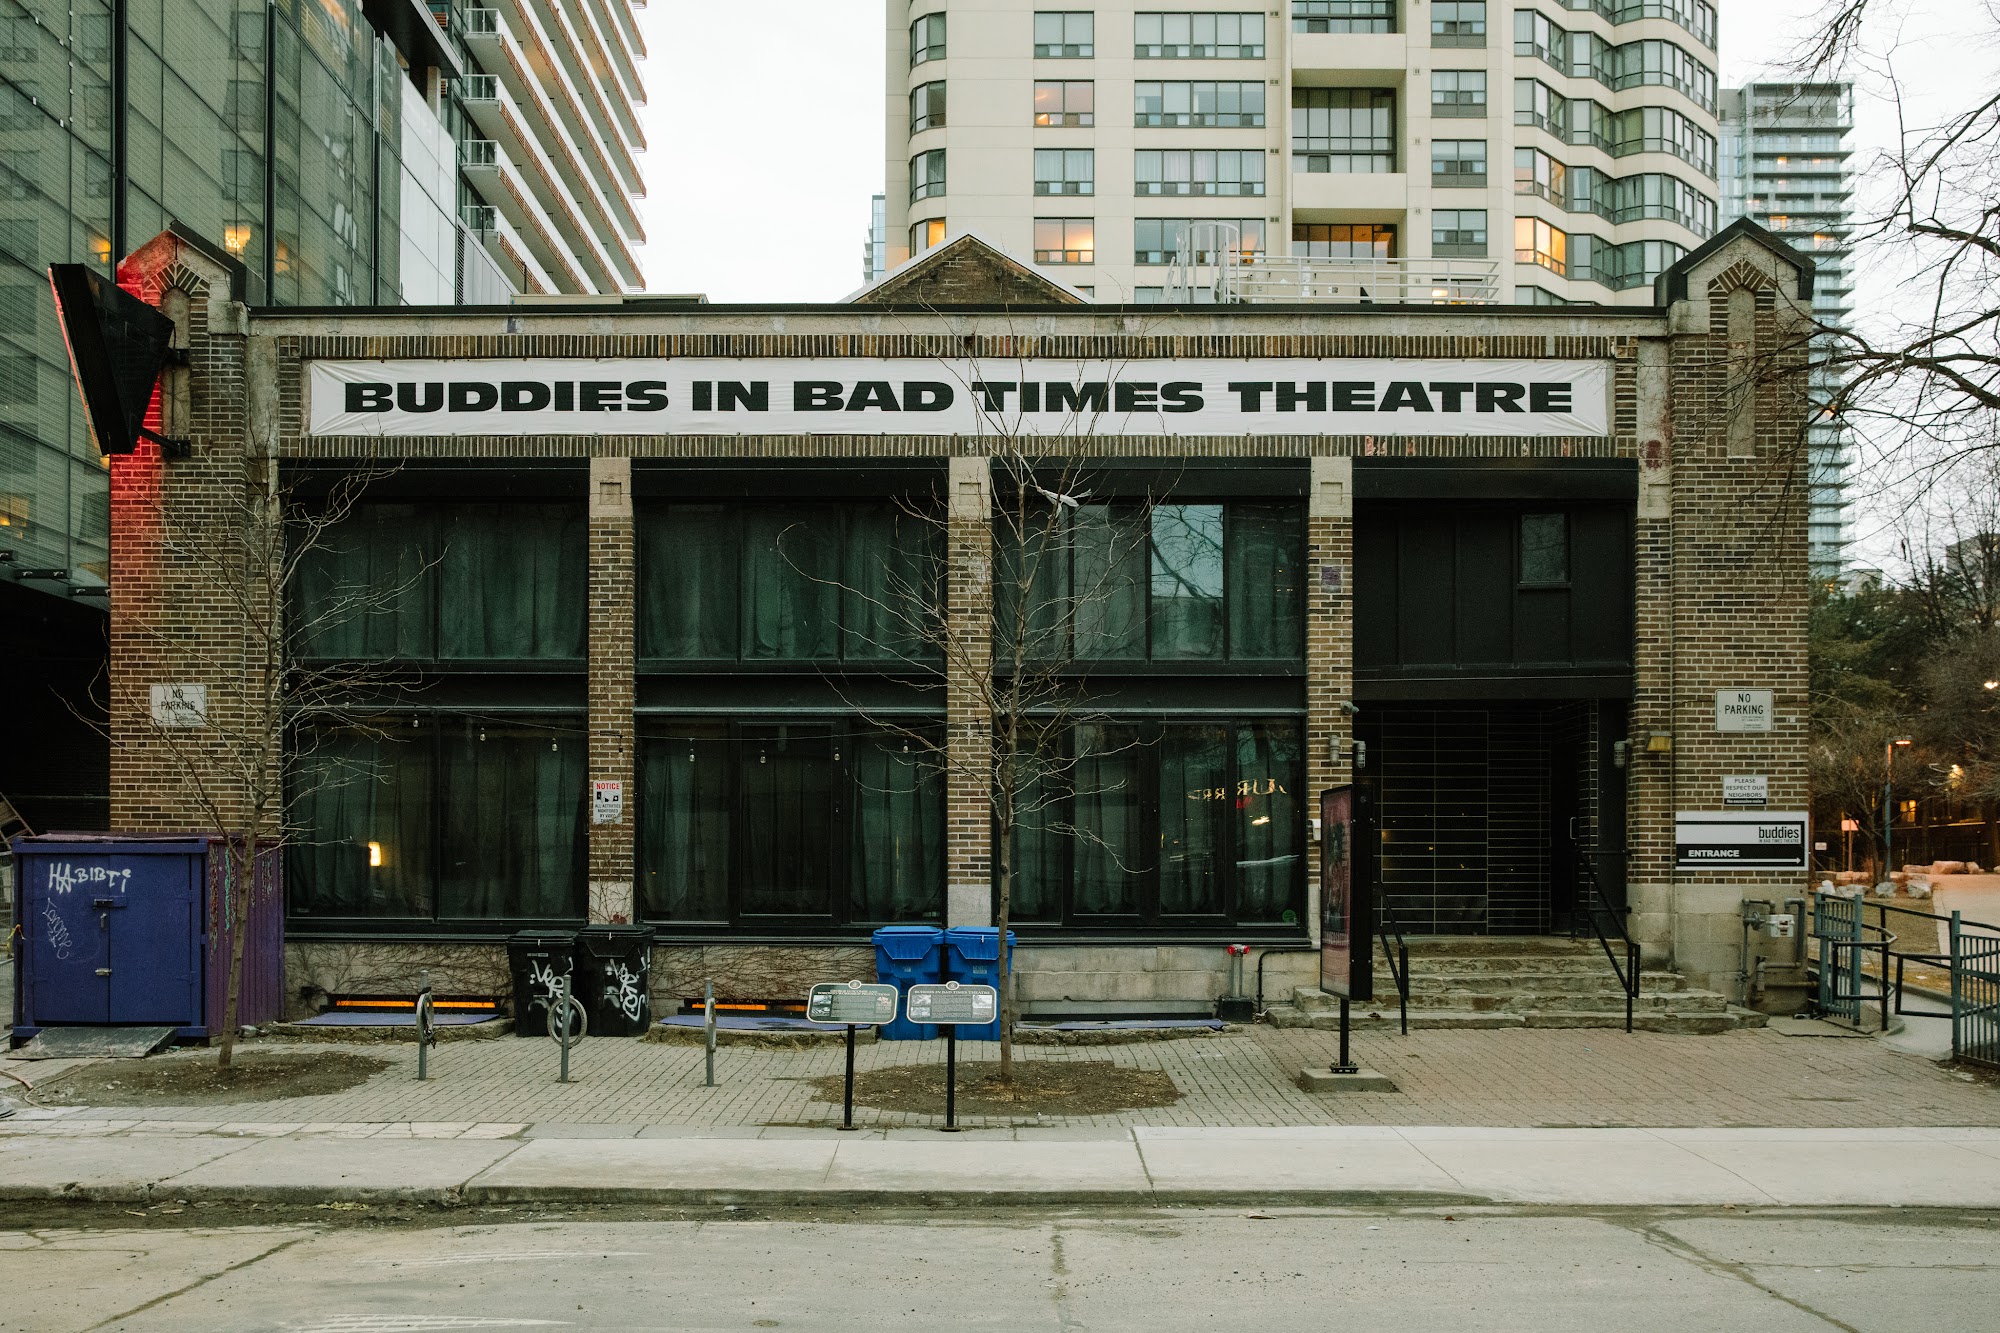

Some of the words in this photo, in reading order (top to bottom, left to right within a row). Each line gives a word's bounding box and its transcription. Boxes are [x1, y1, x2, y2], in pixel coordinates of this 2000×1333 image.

[344, 380, 669, 413] BUDDIES
[692, 380, 769, 413] IN
[793, 381, 954, 413] BAD
[971, 381, 1205, 413] TIMES
[1228, 381, 1572, 413] THEATRE
[172, 689, 184, 699] NO
[1737, 693, 1751, 703] NO
[160, 700, 196, 711] PARKING
[1724, 704, 1764, 715] PARKING
[596, 782, 620, 790] NOTICE
[1758, 826, 1800, 839] buddies
[1687, 849, 1740, 858] ENTRANCE
